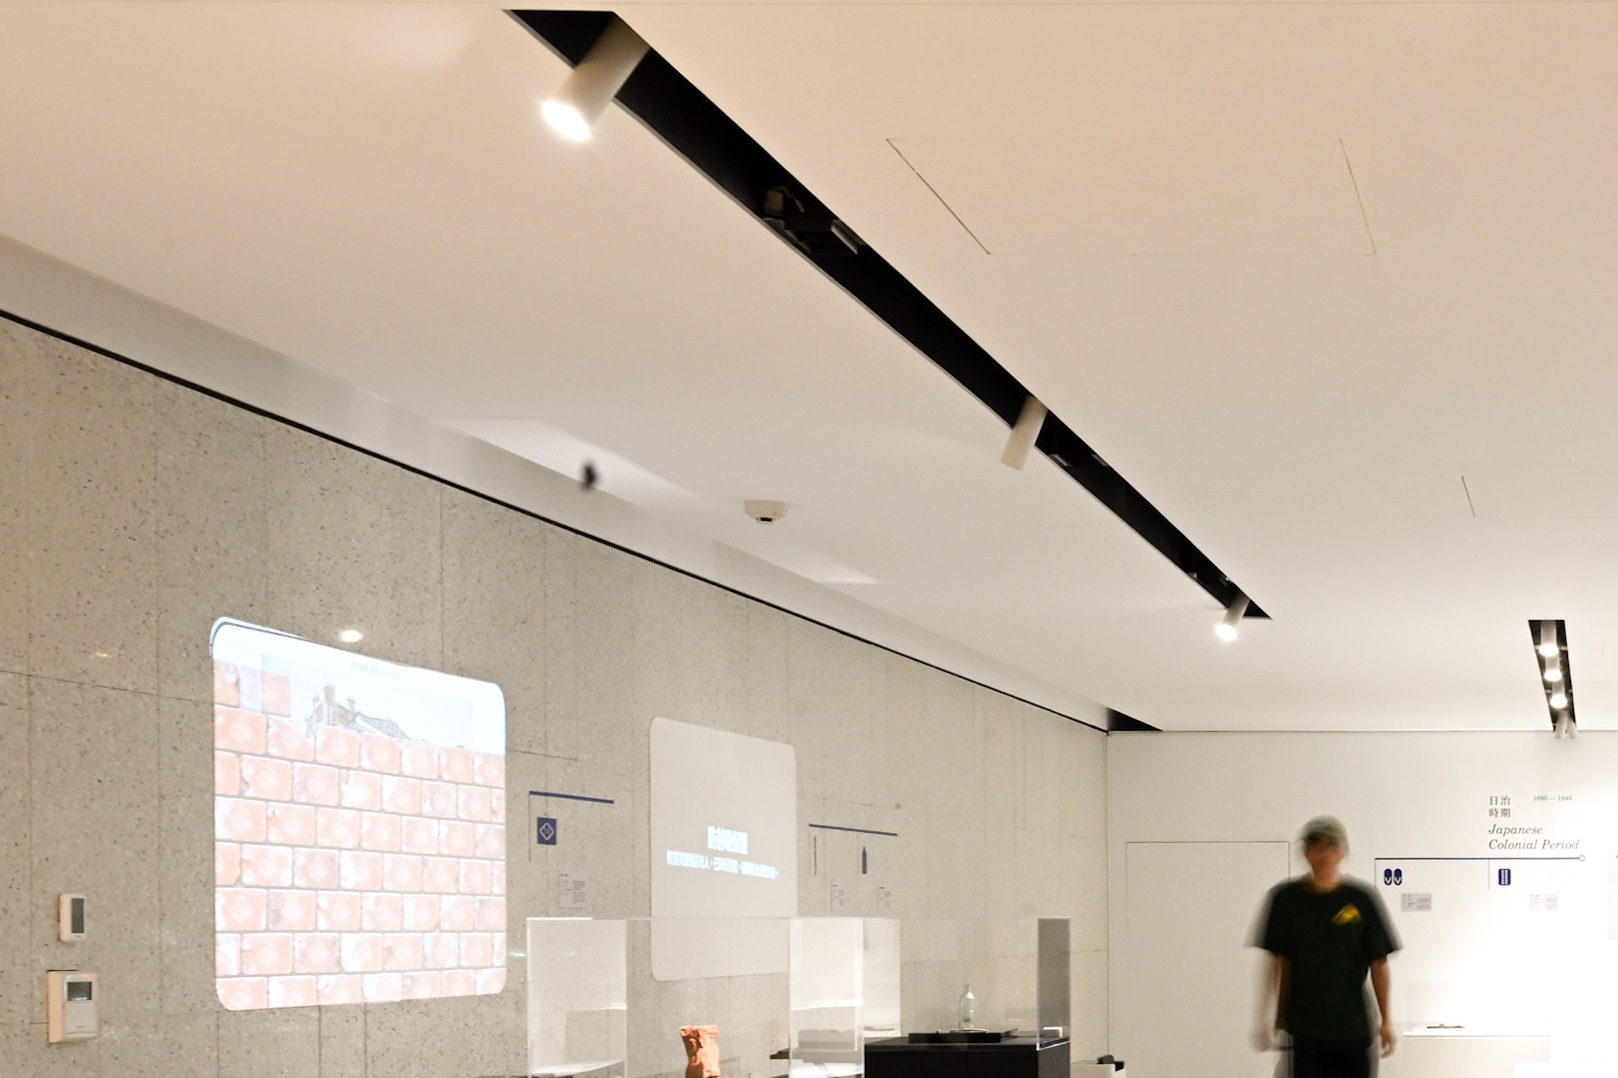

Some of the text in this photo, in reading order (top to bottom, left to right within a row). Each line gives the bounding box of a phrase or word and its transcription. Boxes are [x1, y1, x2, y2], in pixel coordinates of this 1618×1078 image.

[1489, 795, 1511, 806] 日治
[1488, 808, 1511, 818] 時期
[1488, 824, 1543, 837] Japanese
[1488, 838, 1580, 850] Colonial Period
